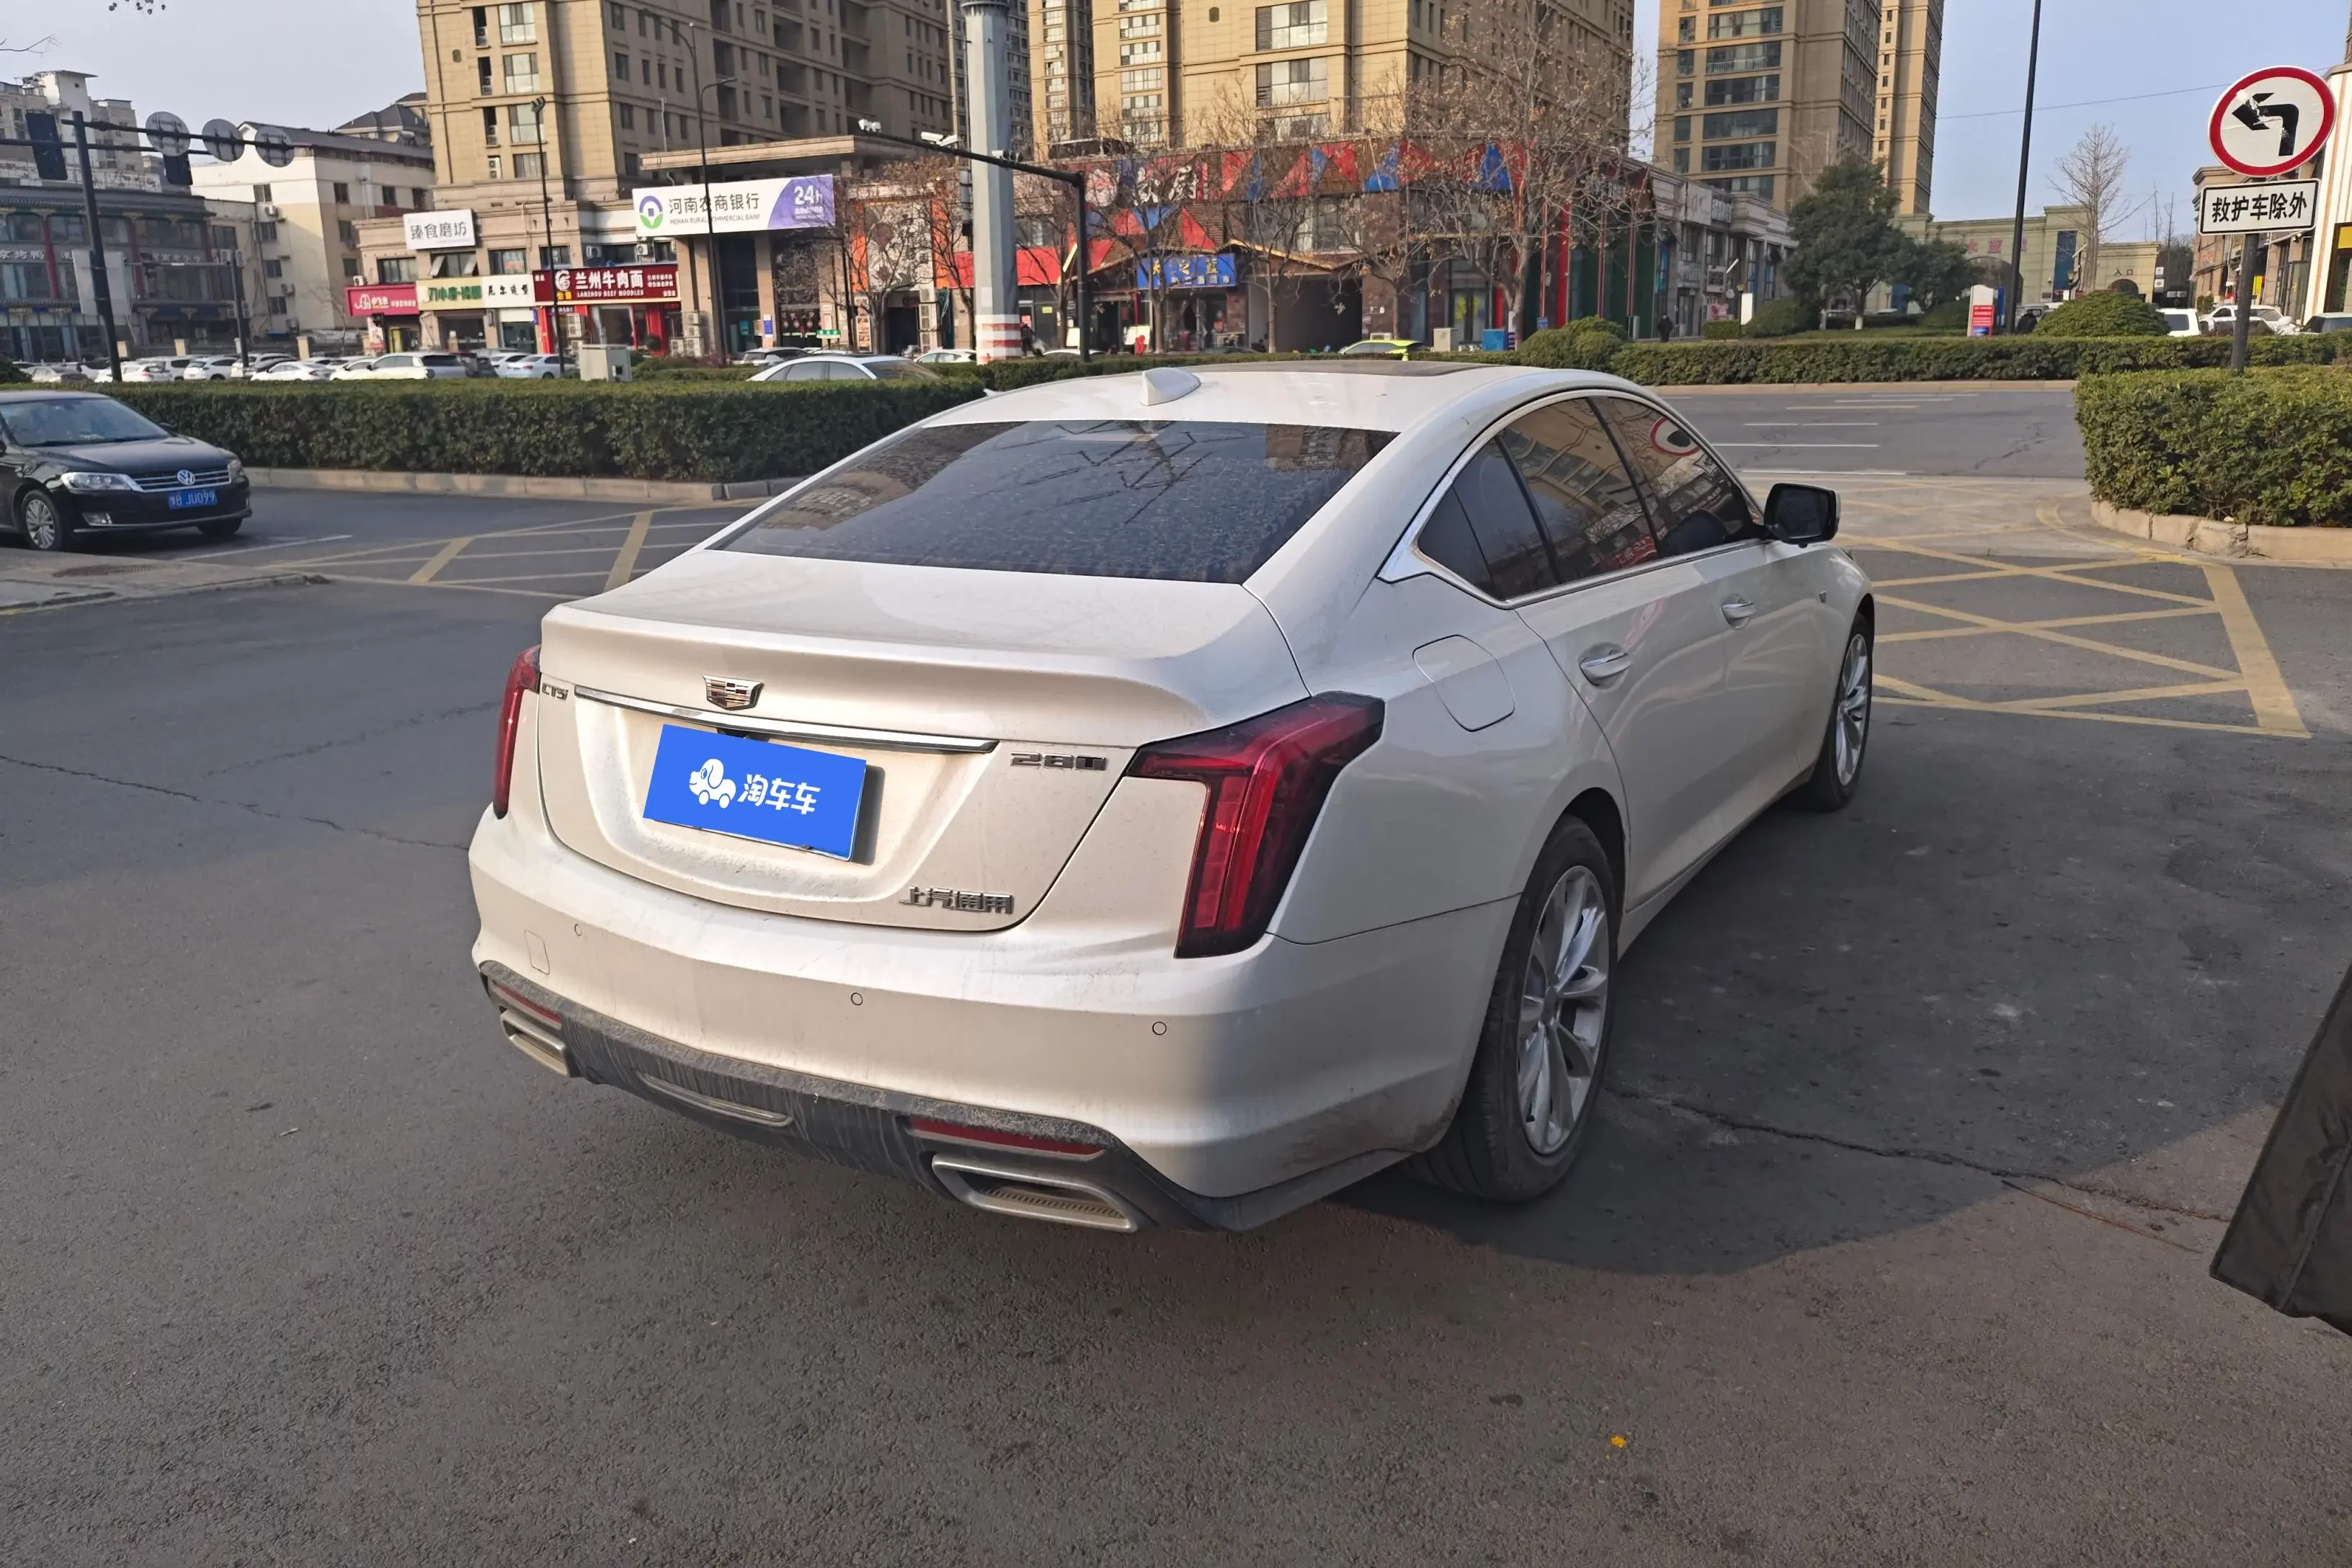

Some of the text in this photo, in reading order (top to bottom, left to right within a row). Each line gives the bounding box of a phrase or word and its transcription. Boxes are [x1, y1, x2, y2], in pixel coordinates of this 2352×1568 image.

[669, 193, 760, 214] 河南农商银行
[2212, 191, 2307, 223] 救护车除外
[410, 221, 467, 240] 臻食磨坊
[488, 284, 529, 296] 尼尔造型
[575, 270, 643, 290] 兰州牛肉面
[1010, 752, 1108, 771] 28T
[899, 886, 1015, 914] 上汽通用
